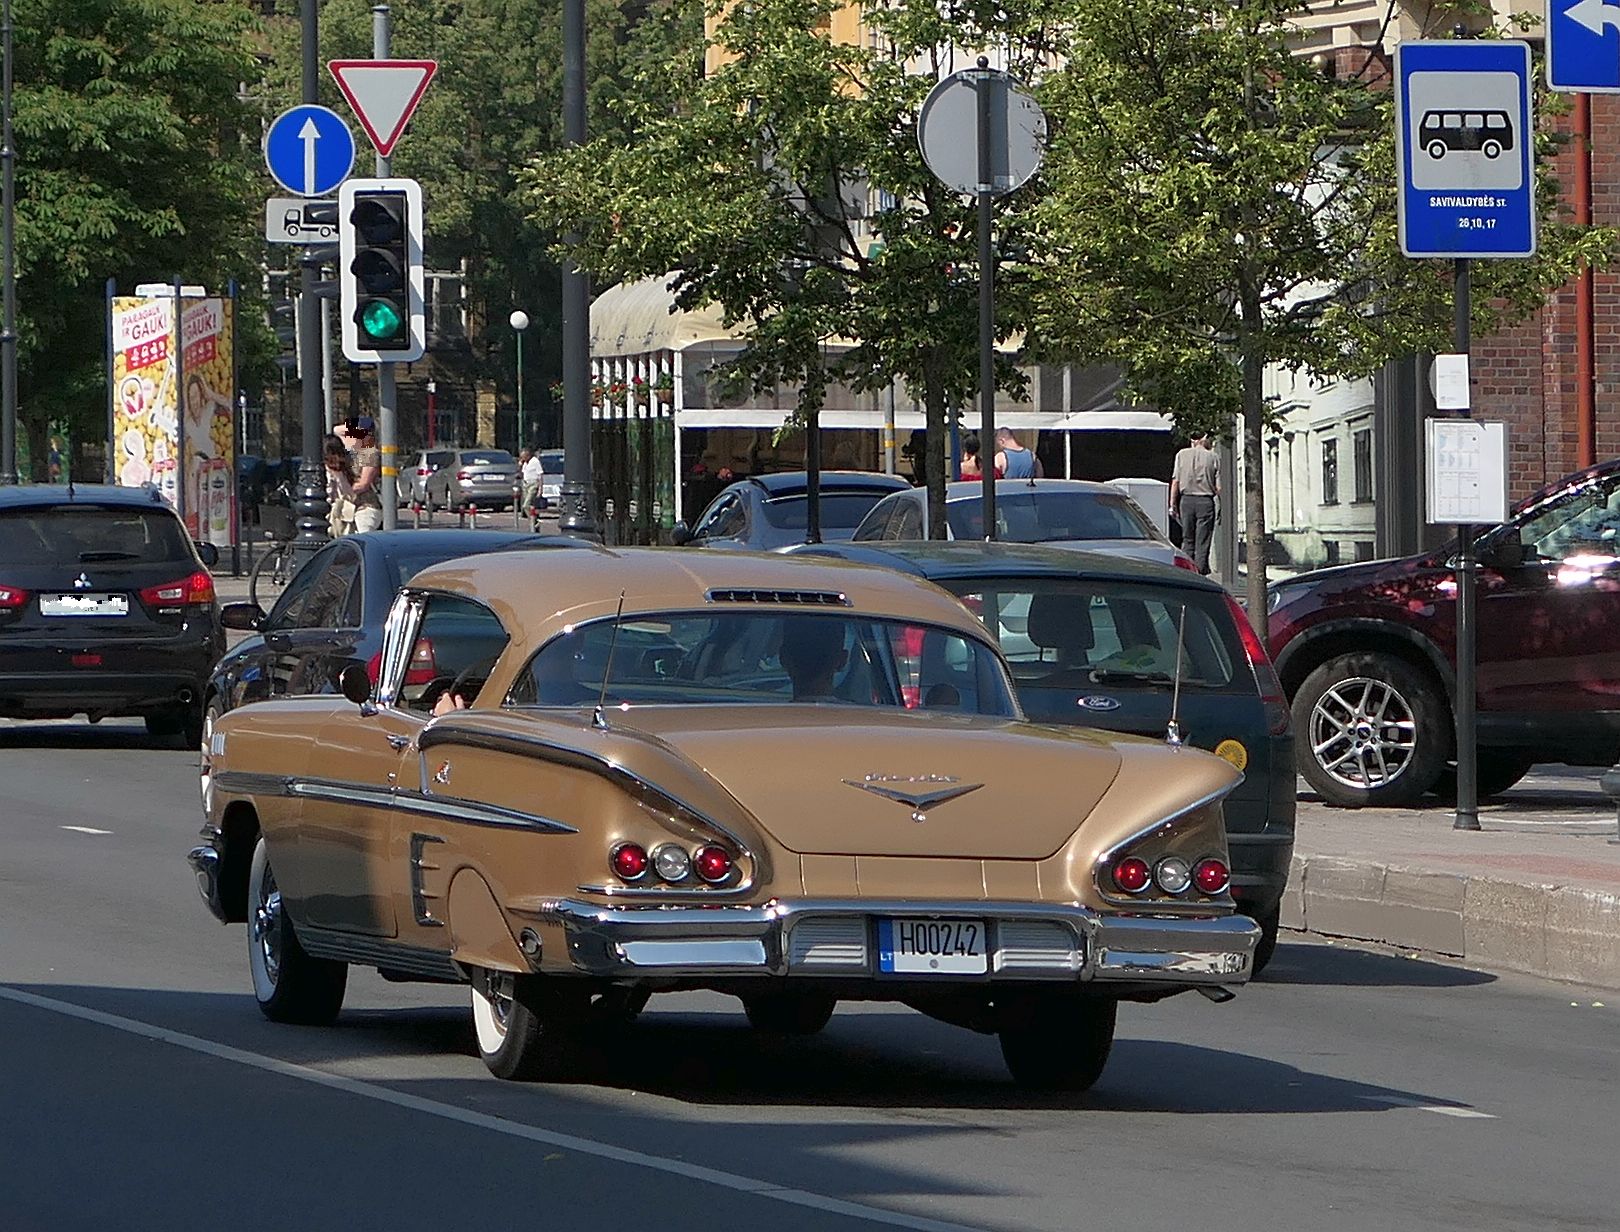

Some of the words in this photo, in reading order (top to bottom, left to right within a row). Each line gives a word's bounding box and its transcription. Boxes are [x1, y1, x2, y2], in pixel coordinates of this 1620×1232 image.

[1429, 194, 1495, 208] SAVIVALDYBĖS
[131, 312, 168, 341] GAUK!
[900, 922, 979, 957] H00242
[880, 952, 893, 961] LT
